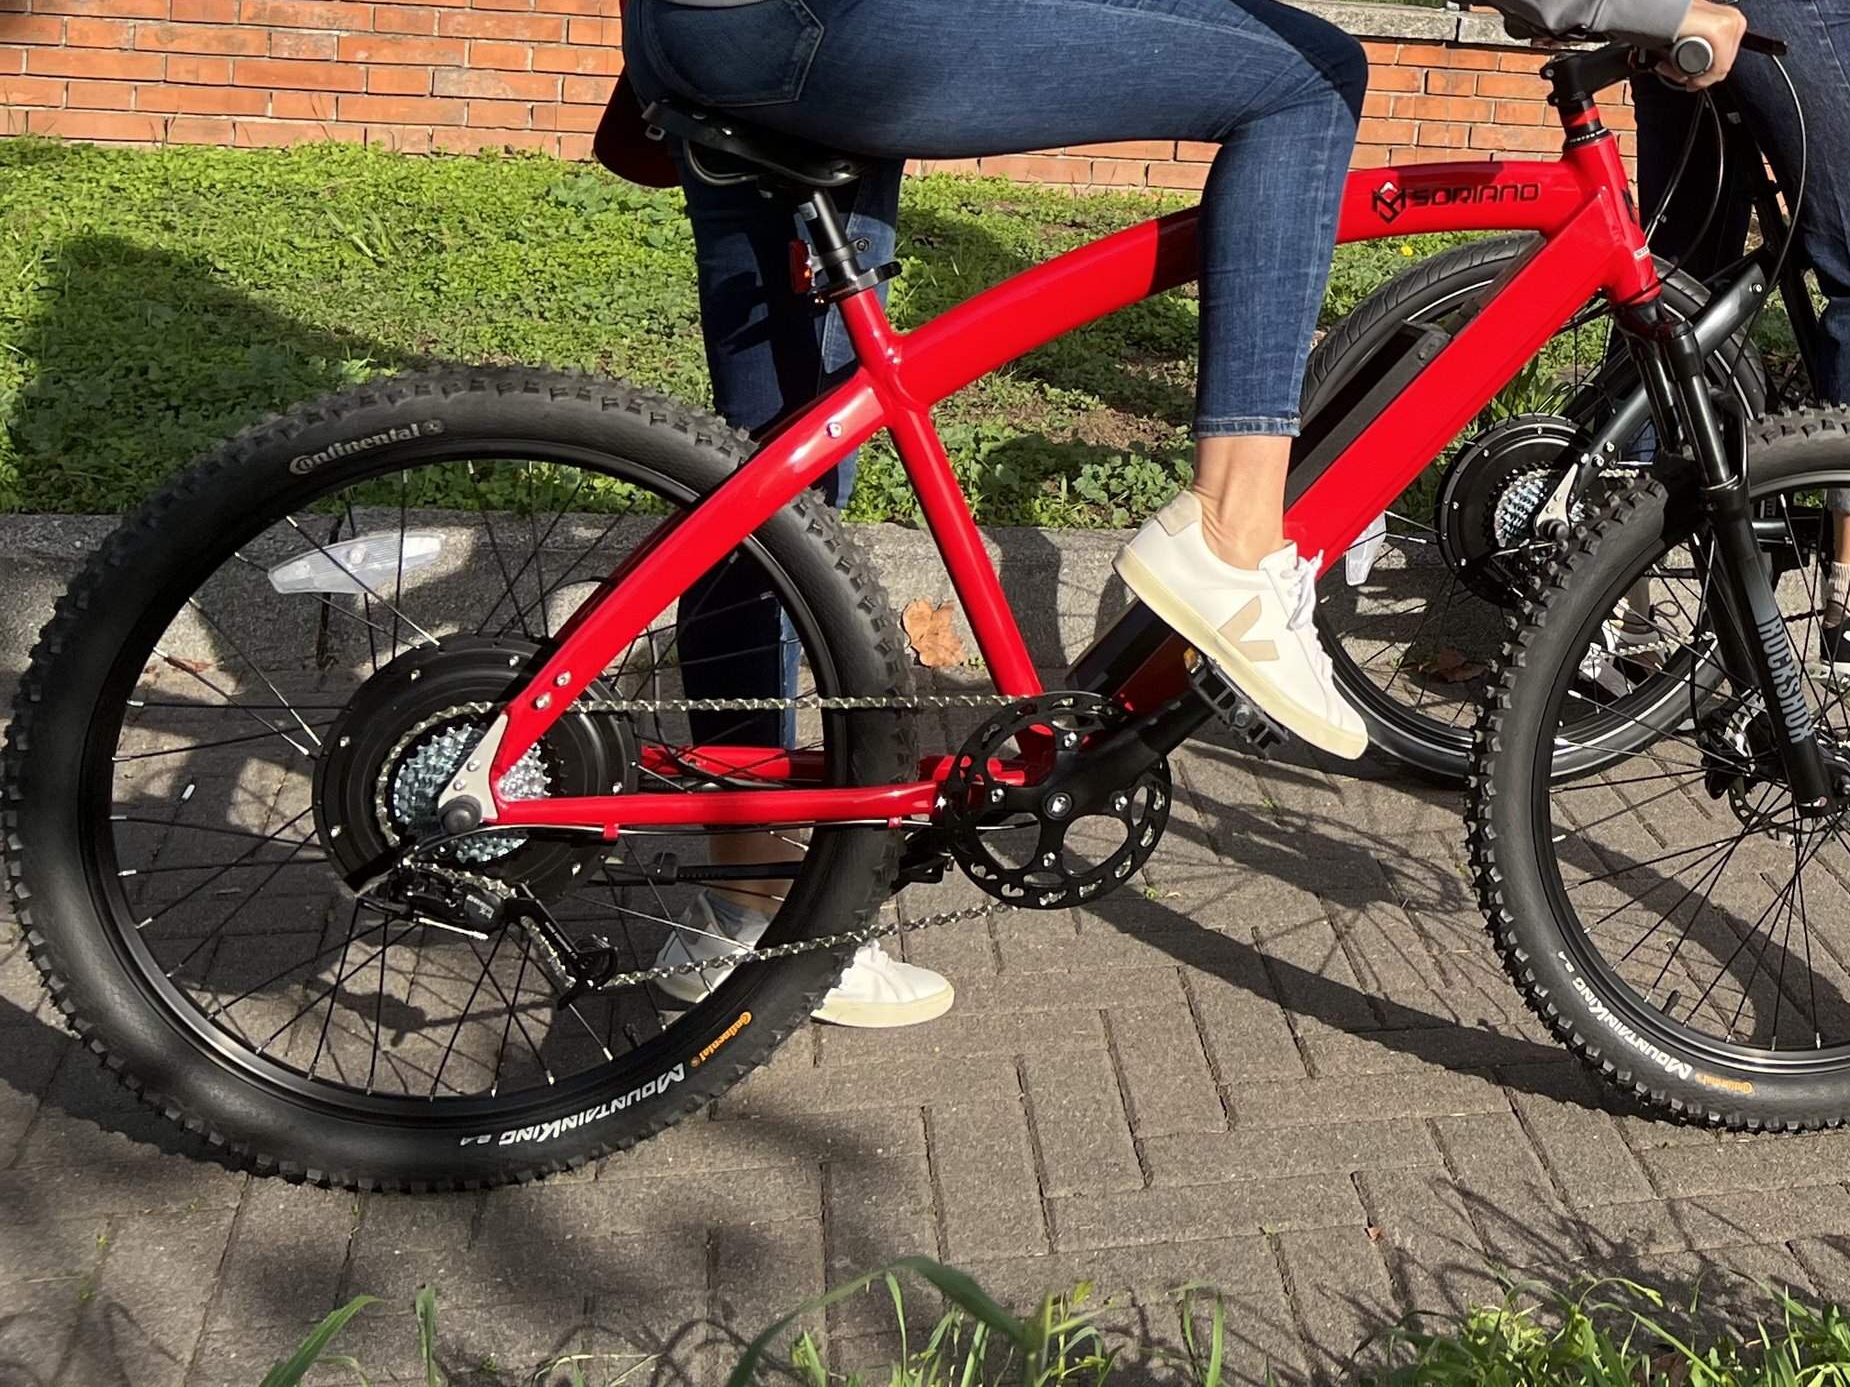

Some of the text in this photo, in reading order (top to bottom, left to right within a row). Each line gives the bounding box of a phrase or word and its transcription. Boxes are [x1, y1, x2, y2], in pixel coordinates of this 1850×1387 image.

[1409, 183, 1541, 207] SORIANO
[289, 423, 421, 475] Continental
[1758, 616, 1814, 744] ROCKSHOX
[699, 1011, 752, 1062] Continental
